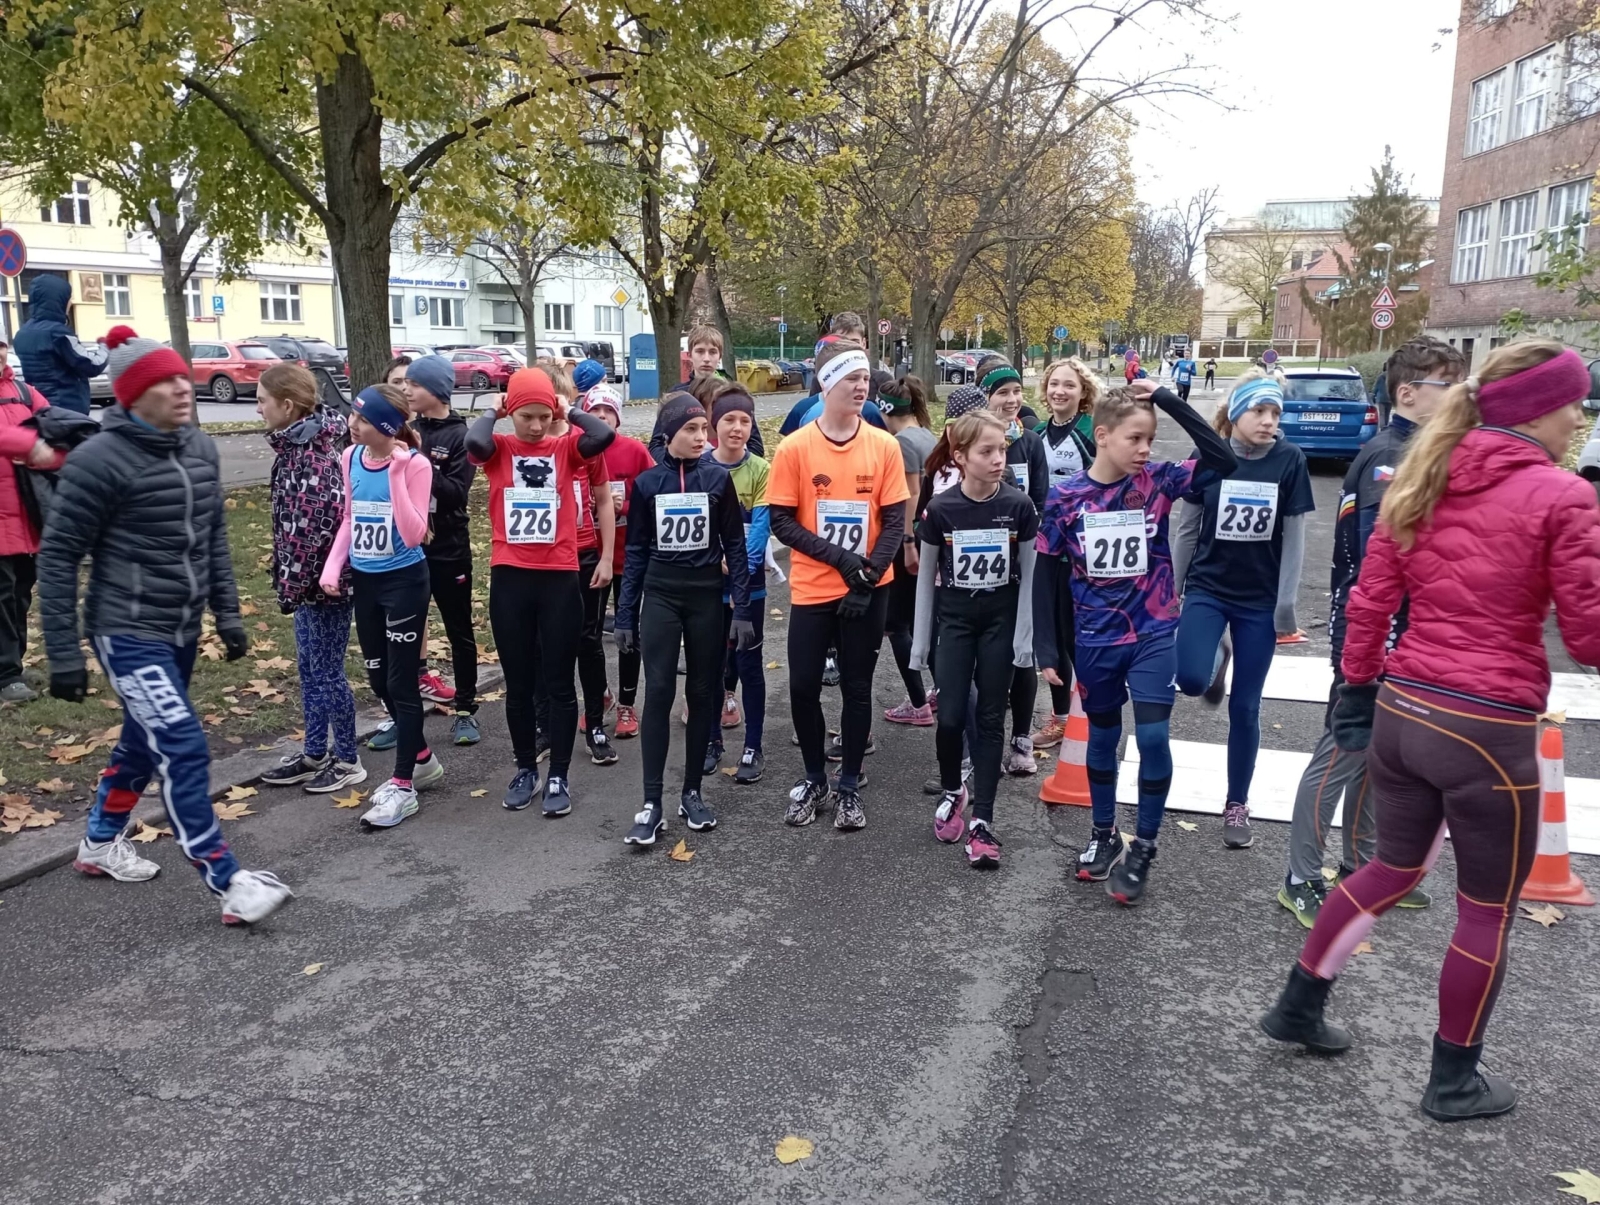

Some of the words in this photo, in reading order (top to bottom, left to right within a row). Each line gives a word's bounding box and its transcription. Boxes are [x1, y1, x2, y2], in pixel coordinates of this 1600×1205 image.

[214, 298, 221, 307] P
[1377, 314, 1390, 322] 20
[508, 509, 552, 536] 226
[660, 516, 706, 543] 208
[1220, 504, 1273, 534] 238
[354, 523, 388, 551] 230
[824, 523, 862, 553] 219
[1093, 536, 1140, 569] 218
[956, 554, 1006, 580] 244
[386, 630, 417, 642] PRO
[132, 665, 192, 724] CZECH
